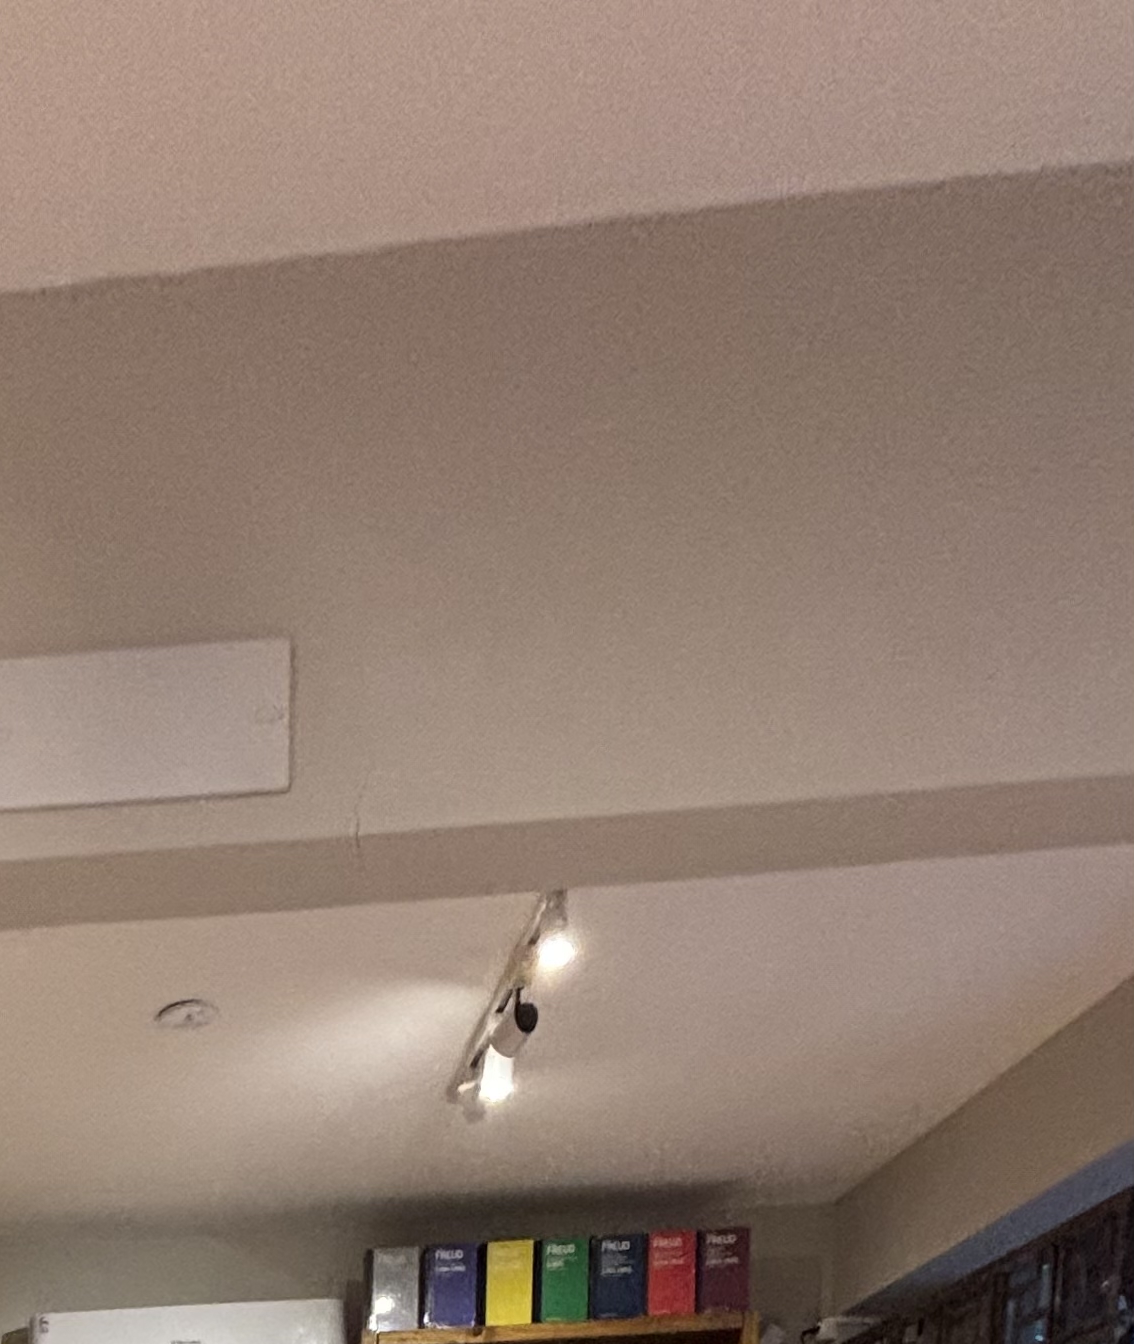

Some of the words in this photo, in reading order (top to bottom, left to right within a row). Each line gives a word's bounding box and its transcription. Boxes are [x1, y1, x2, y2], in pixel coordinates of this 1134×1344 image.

[546, 1243, 576, 1255] FREUD
[601, 1240, 631, 1251] FREUD
[434, 1249, 464, 1260] FREUD
